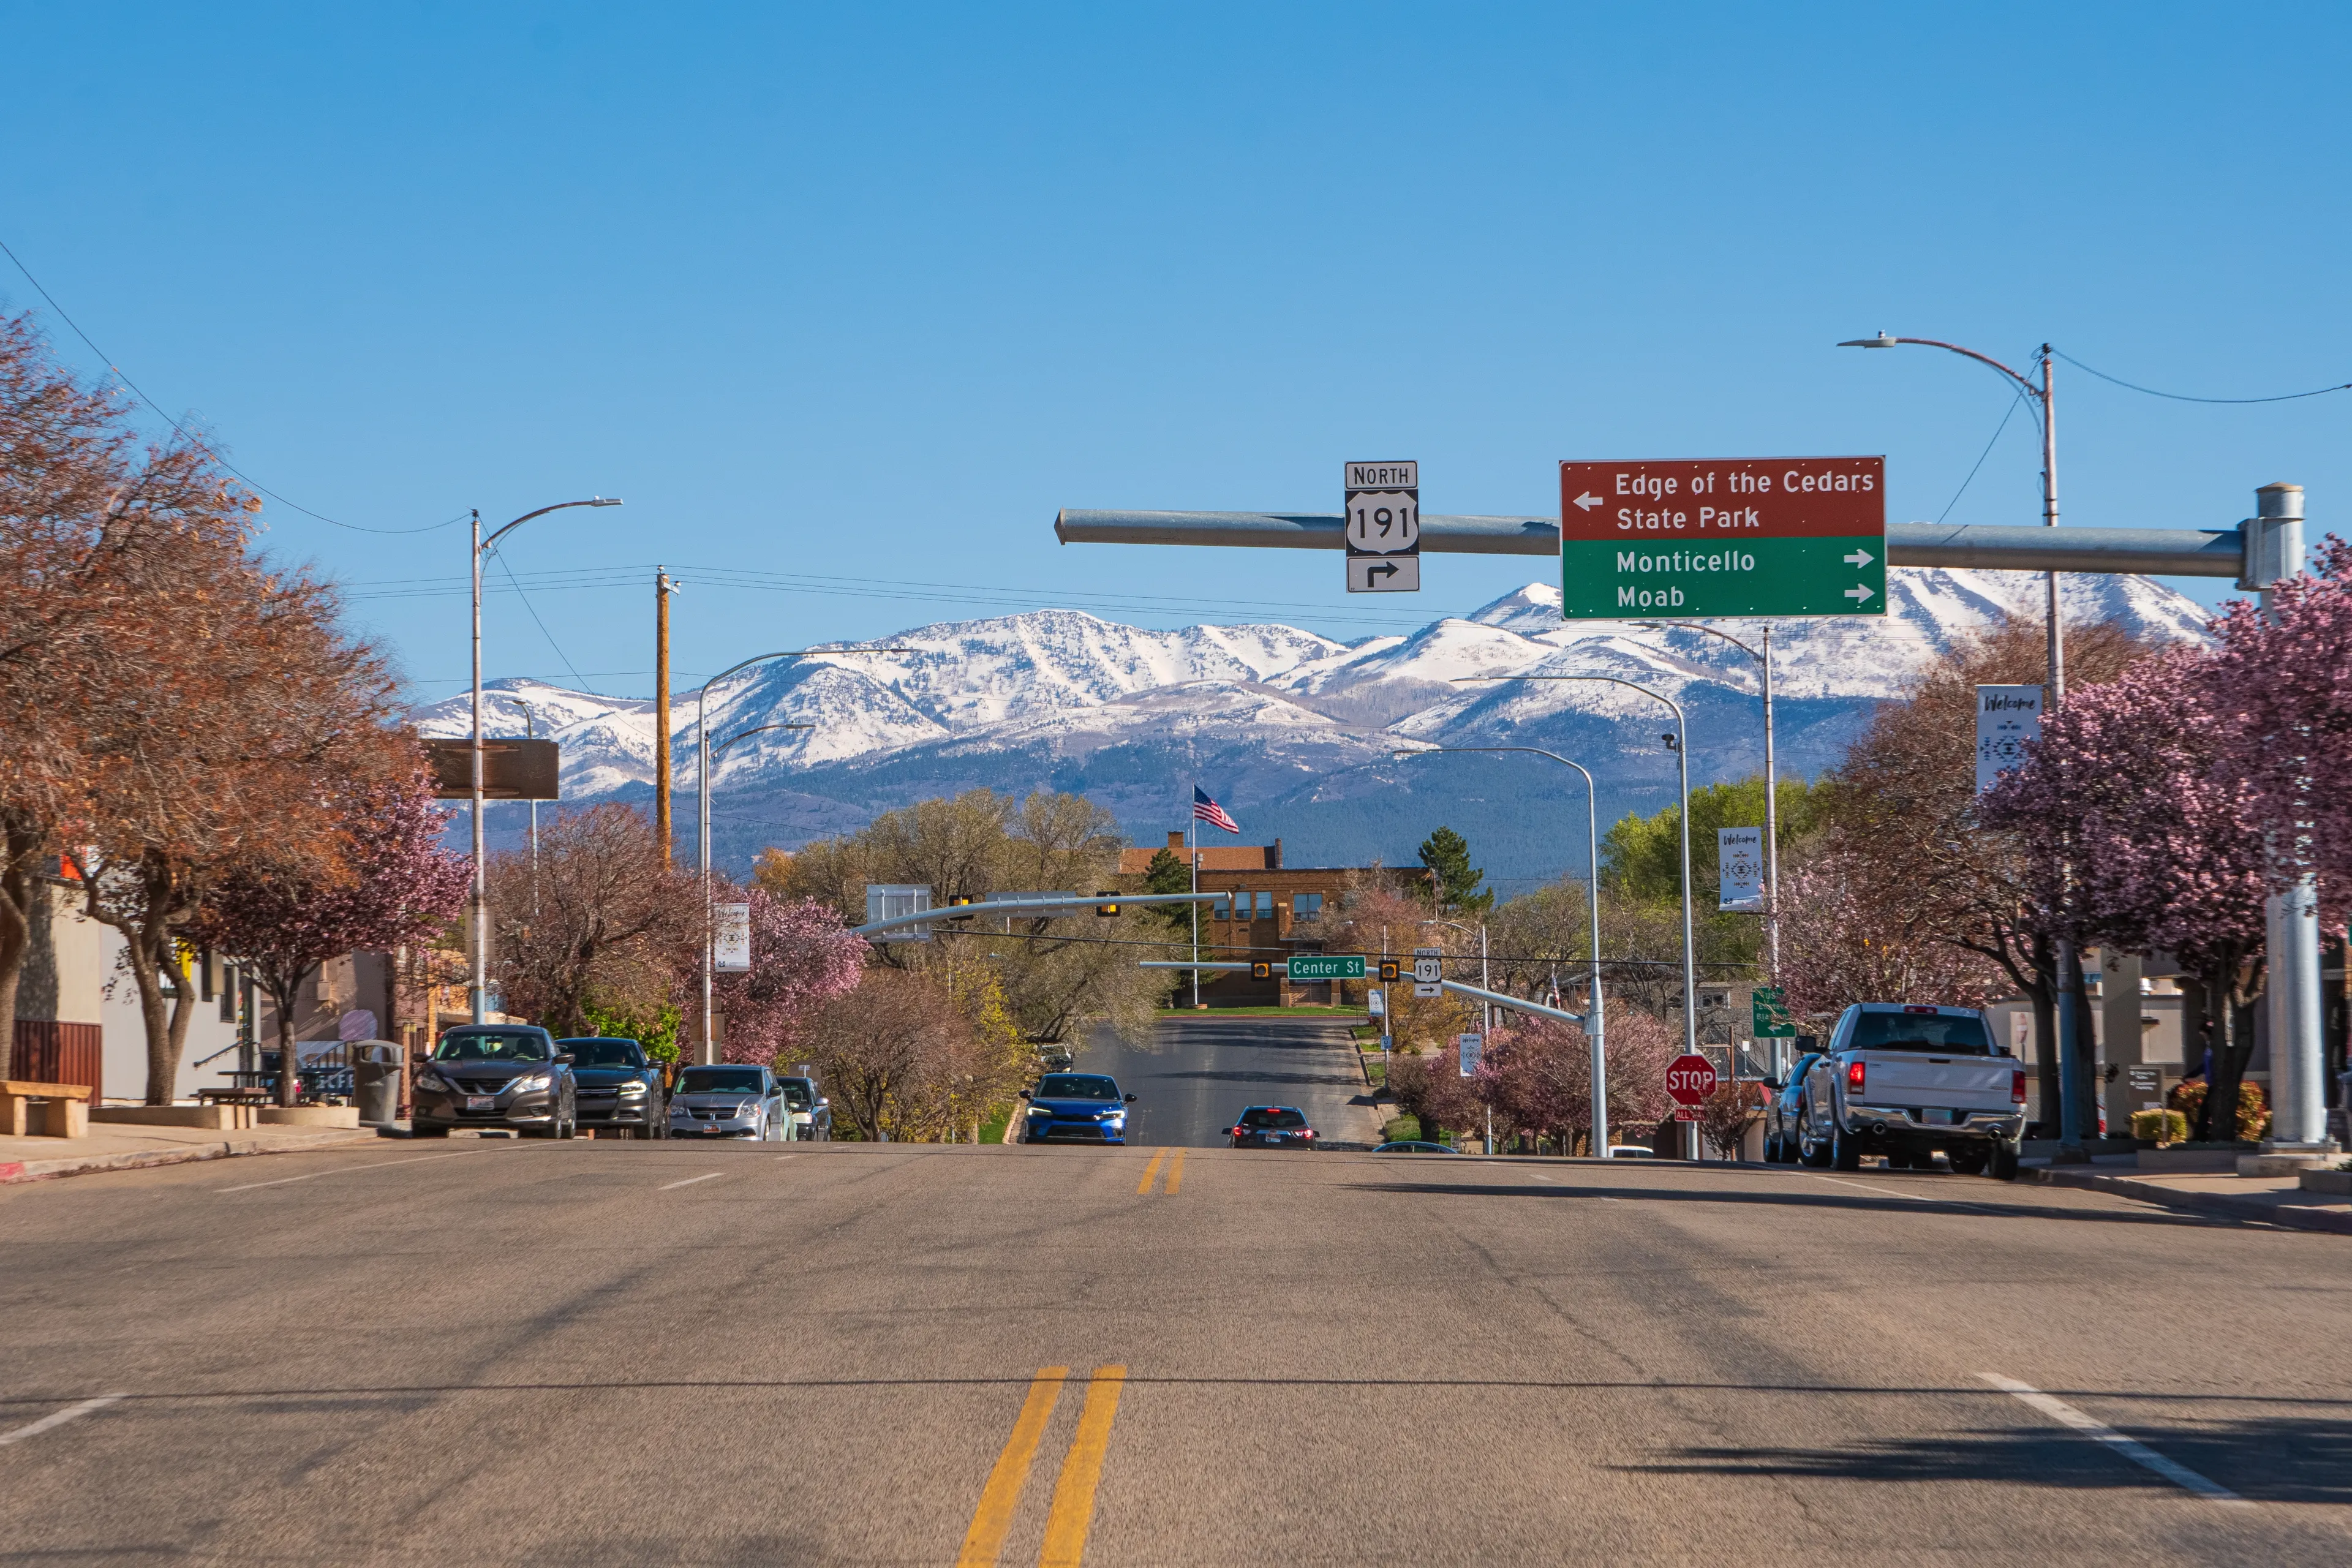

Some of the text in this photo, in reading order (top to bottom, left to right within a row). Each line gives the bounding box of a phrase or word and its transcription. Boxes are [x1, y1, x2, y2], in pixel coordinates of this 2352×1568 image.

[1354, 466, 1409, 484] NORTH
[1615, 470, 1874, 501] Edge of the Cedars
[1357, 507, 1408, 539] 191
[1617, 506, 1760, 530] State Park
[1616, 550, 1755, 573] Monticello
[1618, 586, 1684, 608] Moab
[1985, 693, 2035, 711] Welcome
[1724, 834, 1757, 846] Welcome
[1294, 960, 1360, 974] Center St
[1418, 964, 1438, 977] 191
[1668, 1070, 1714, 1090] STOP
[1676, 1110, 1689, 1119] ALL
